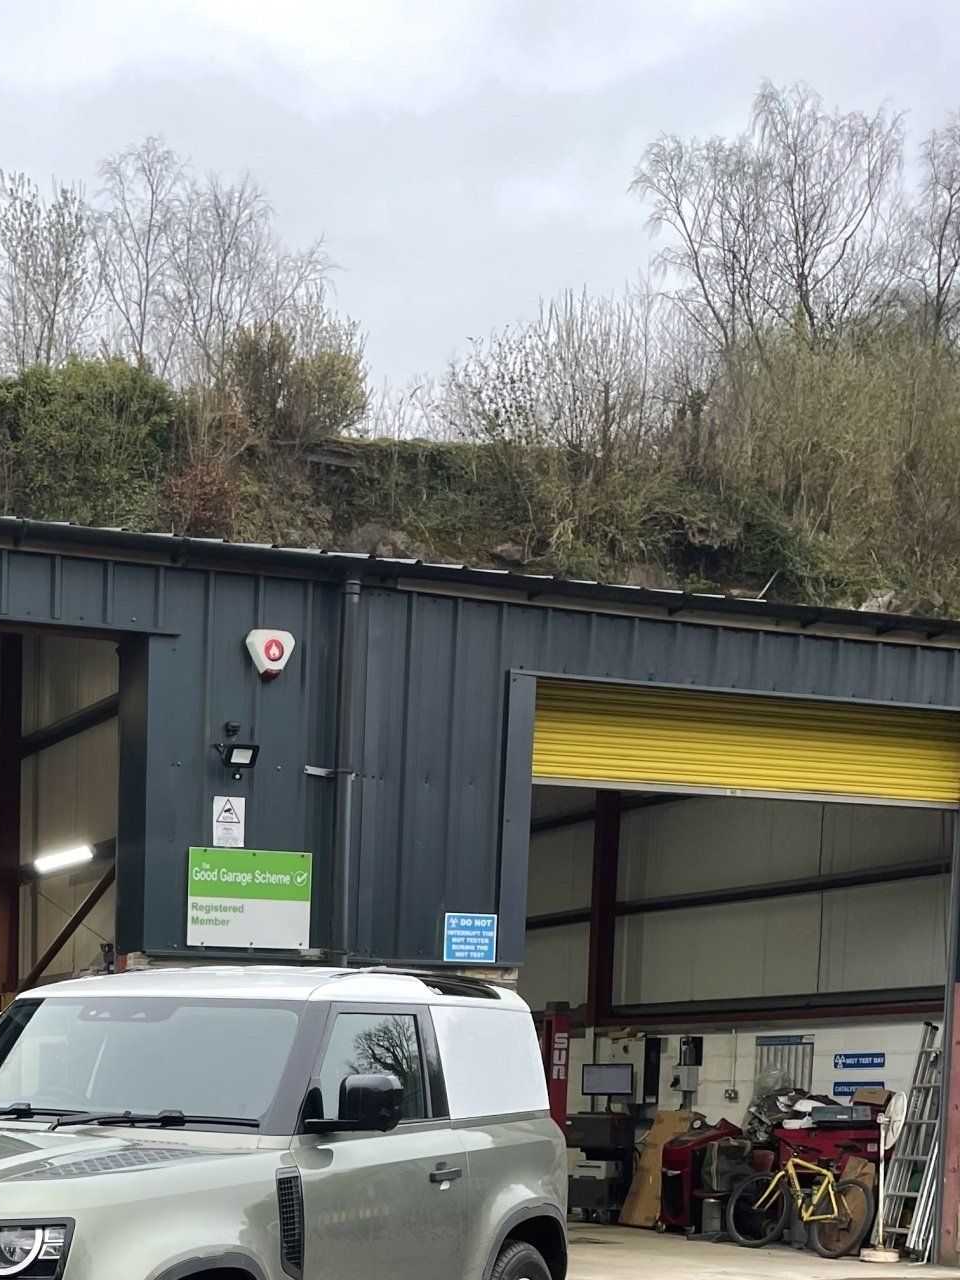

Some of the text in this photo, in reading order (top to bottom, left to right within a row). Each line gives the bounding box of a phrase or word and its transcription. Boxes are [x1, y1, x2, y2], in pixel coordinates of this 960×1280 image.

[192, 867, 291, 886] Good Garage Scheme
[191, 902, 245, 914] Registered
[191, 916, 231, 927] Member
[460, 918, 492, 927] DO NOT
